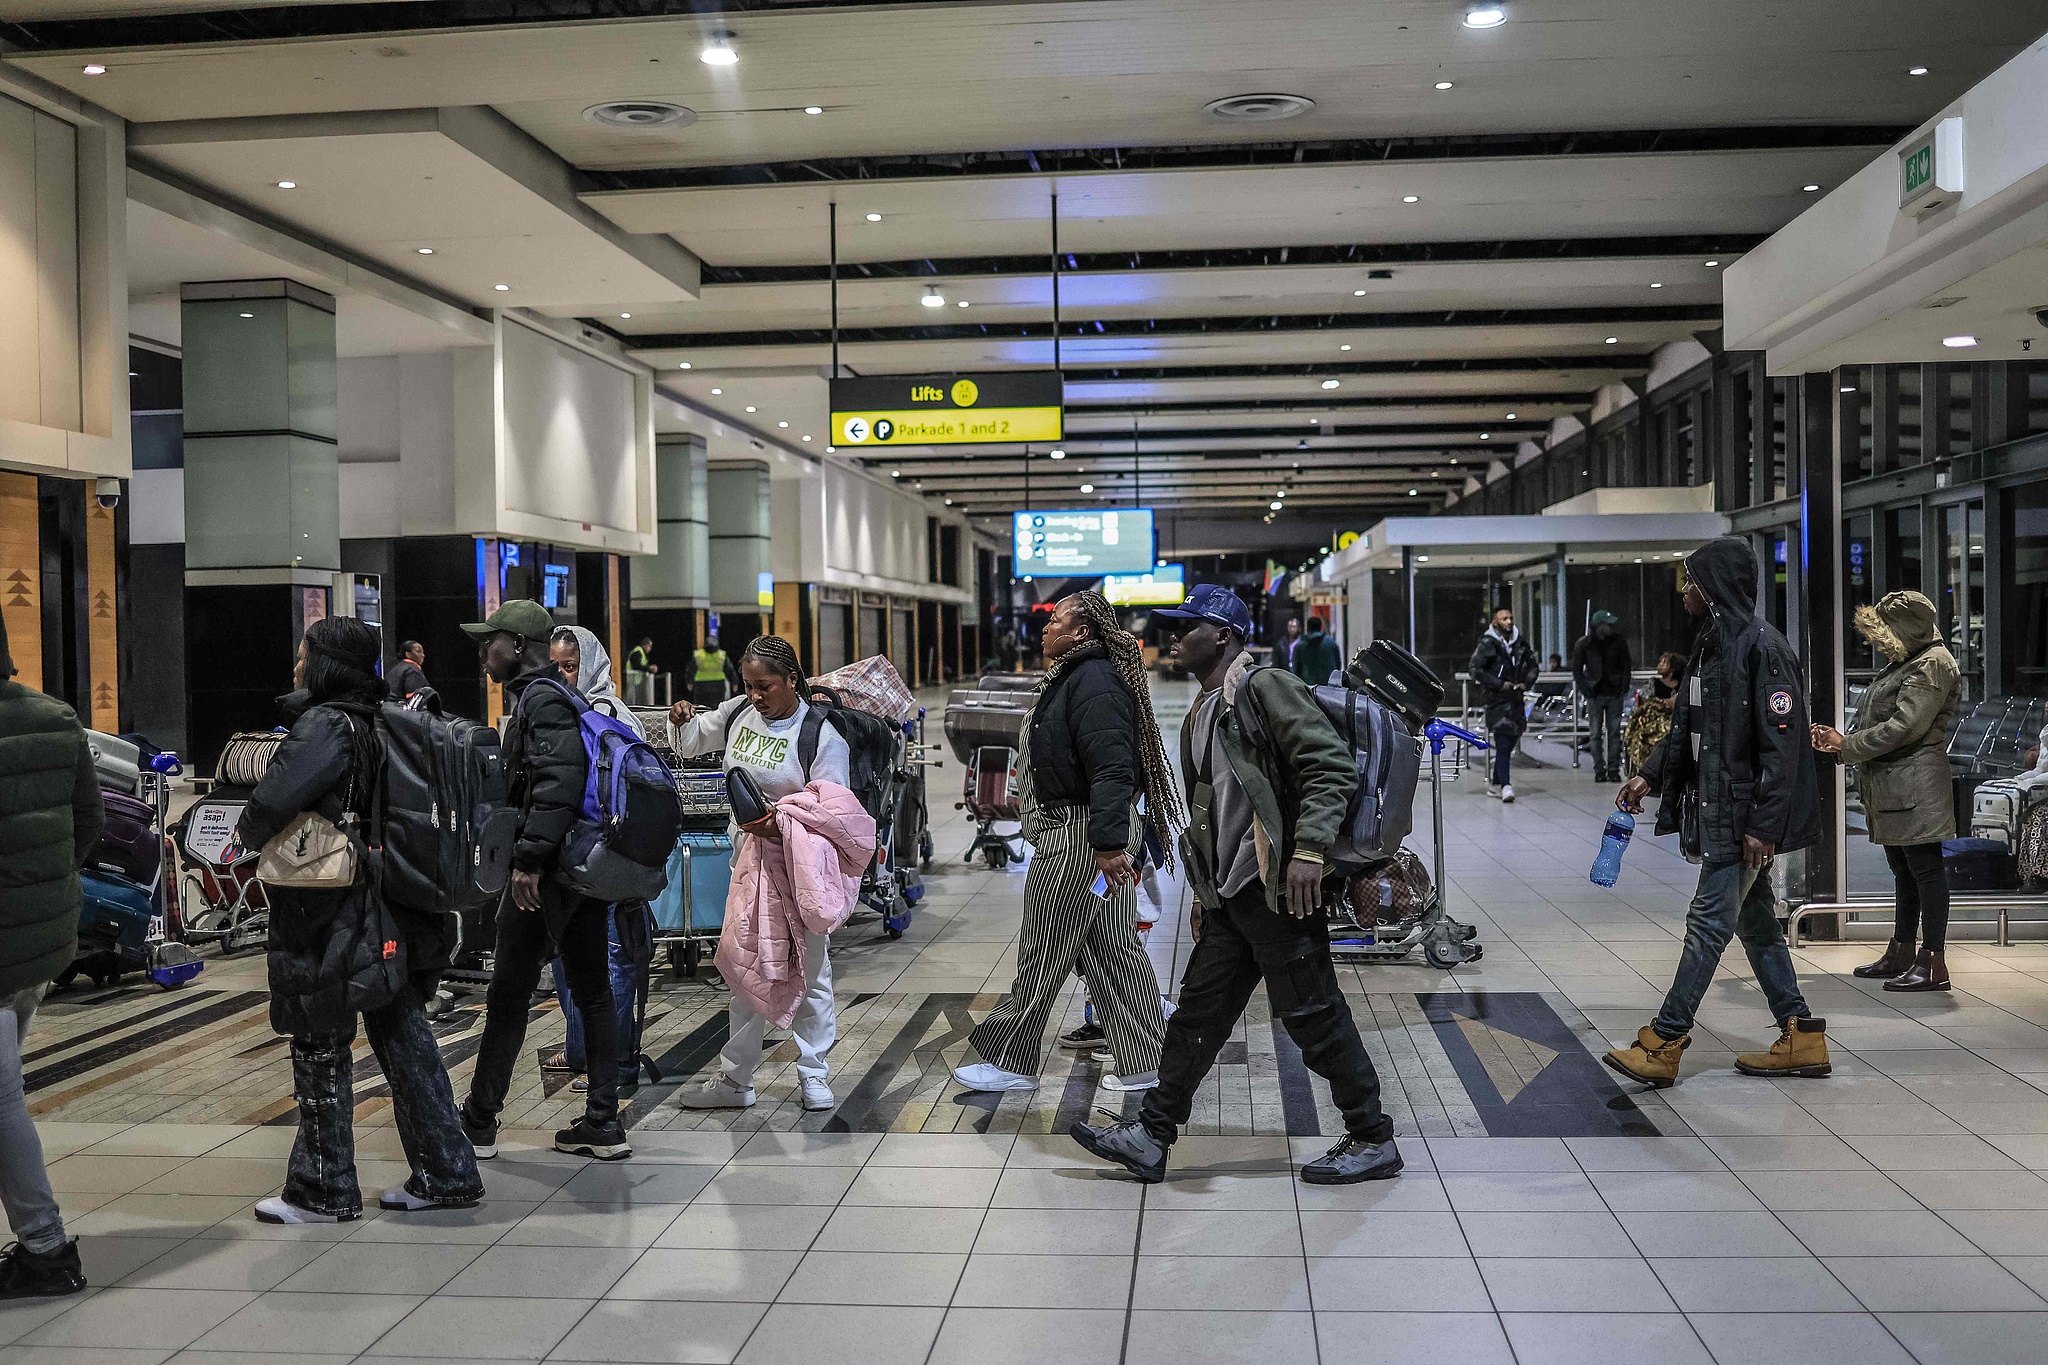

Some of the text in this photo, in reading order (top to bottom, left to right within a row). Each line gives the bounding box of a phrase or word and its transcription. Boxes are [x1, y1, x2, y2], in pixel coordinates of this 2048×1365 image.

[910, 386, 944, 402] Lifts
[877, 420, 1010, 438] P Parkade 1 and 2
[732, 726, 788, 763] NYC
[203, 811, 226, 823] asap!
